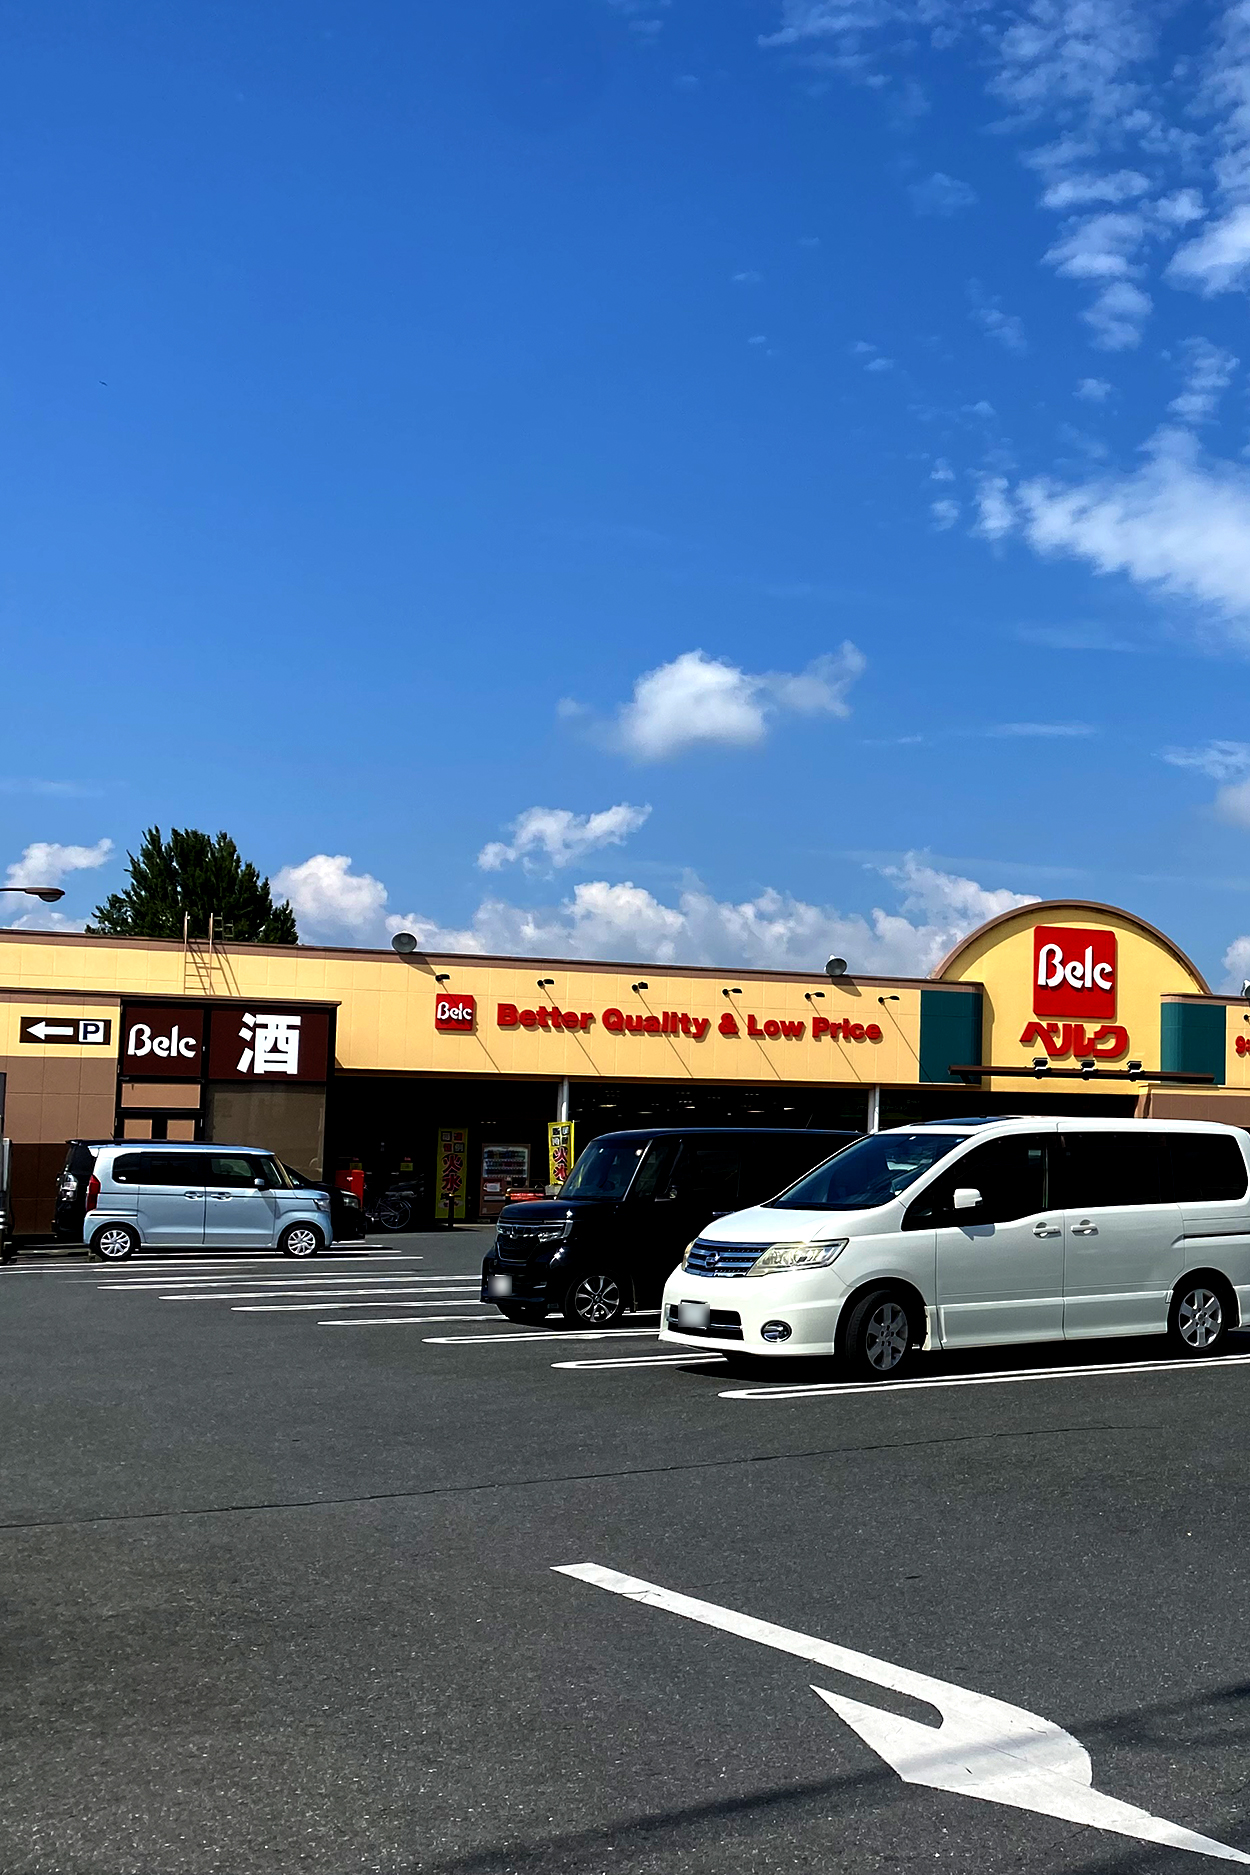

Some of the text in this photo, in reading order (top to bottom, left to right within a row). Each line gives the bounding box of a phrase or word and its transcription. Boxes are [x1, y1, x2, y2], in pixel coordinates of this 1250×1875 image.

[1038, 944, 1113, 990] Belc
[436, 1001, 472, 1021] Belc
[496, 1003, 883, 1040] Better Quality & Low Price
[83, 1023, 100, 1040] P
[127, 1023, 197, 1058] Belc
[236, 1012, 302, 1075] 酒
[1019, 1021, 1129, 1058] ベルク
